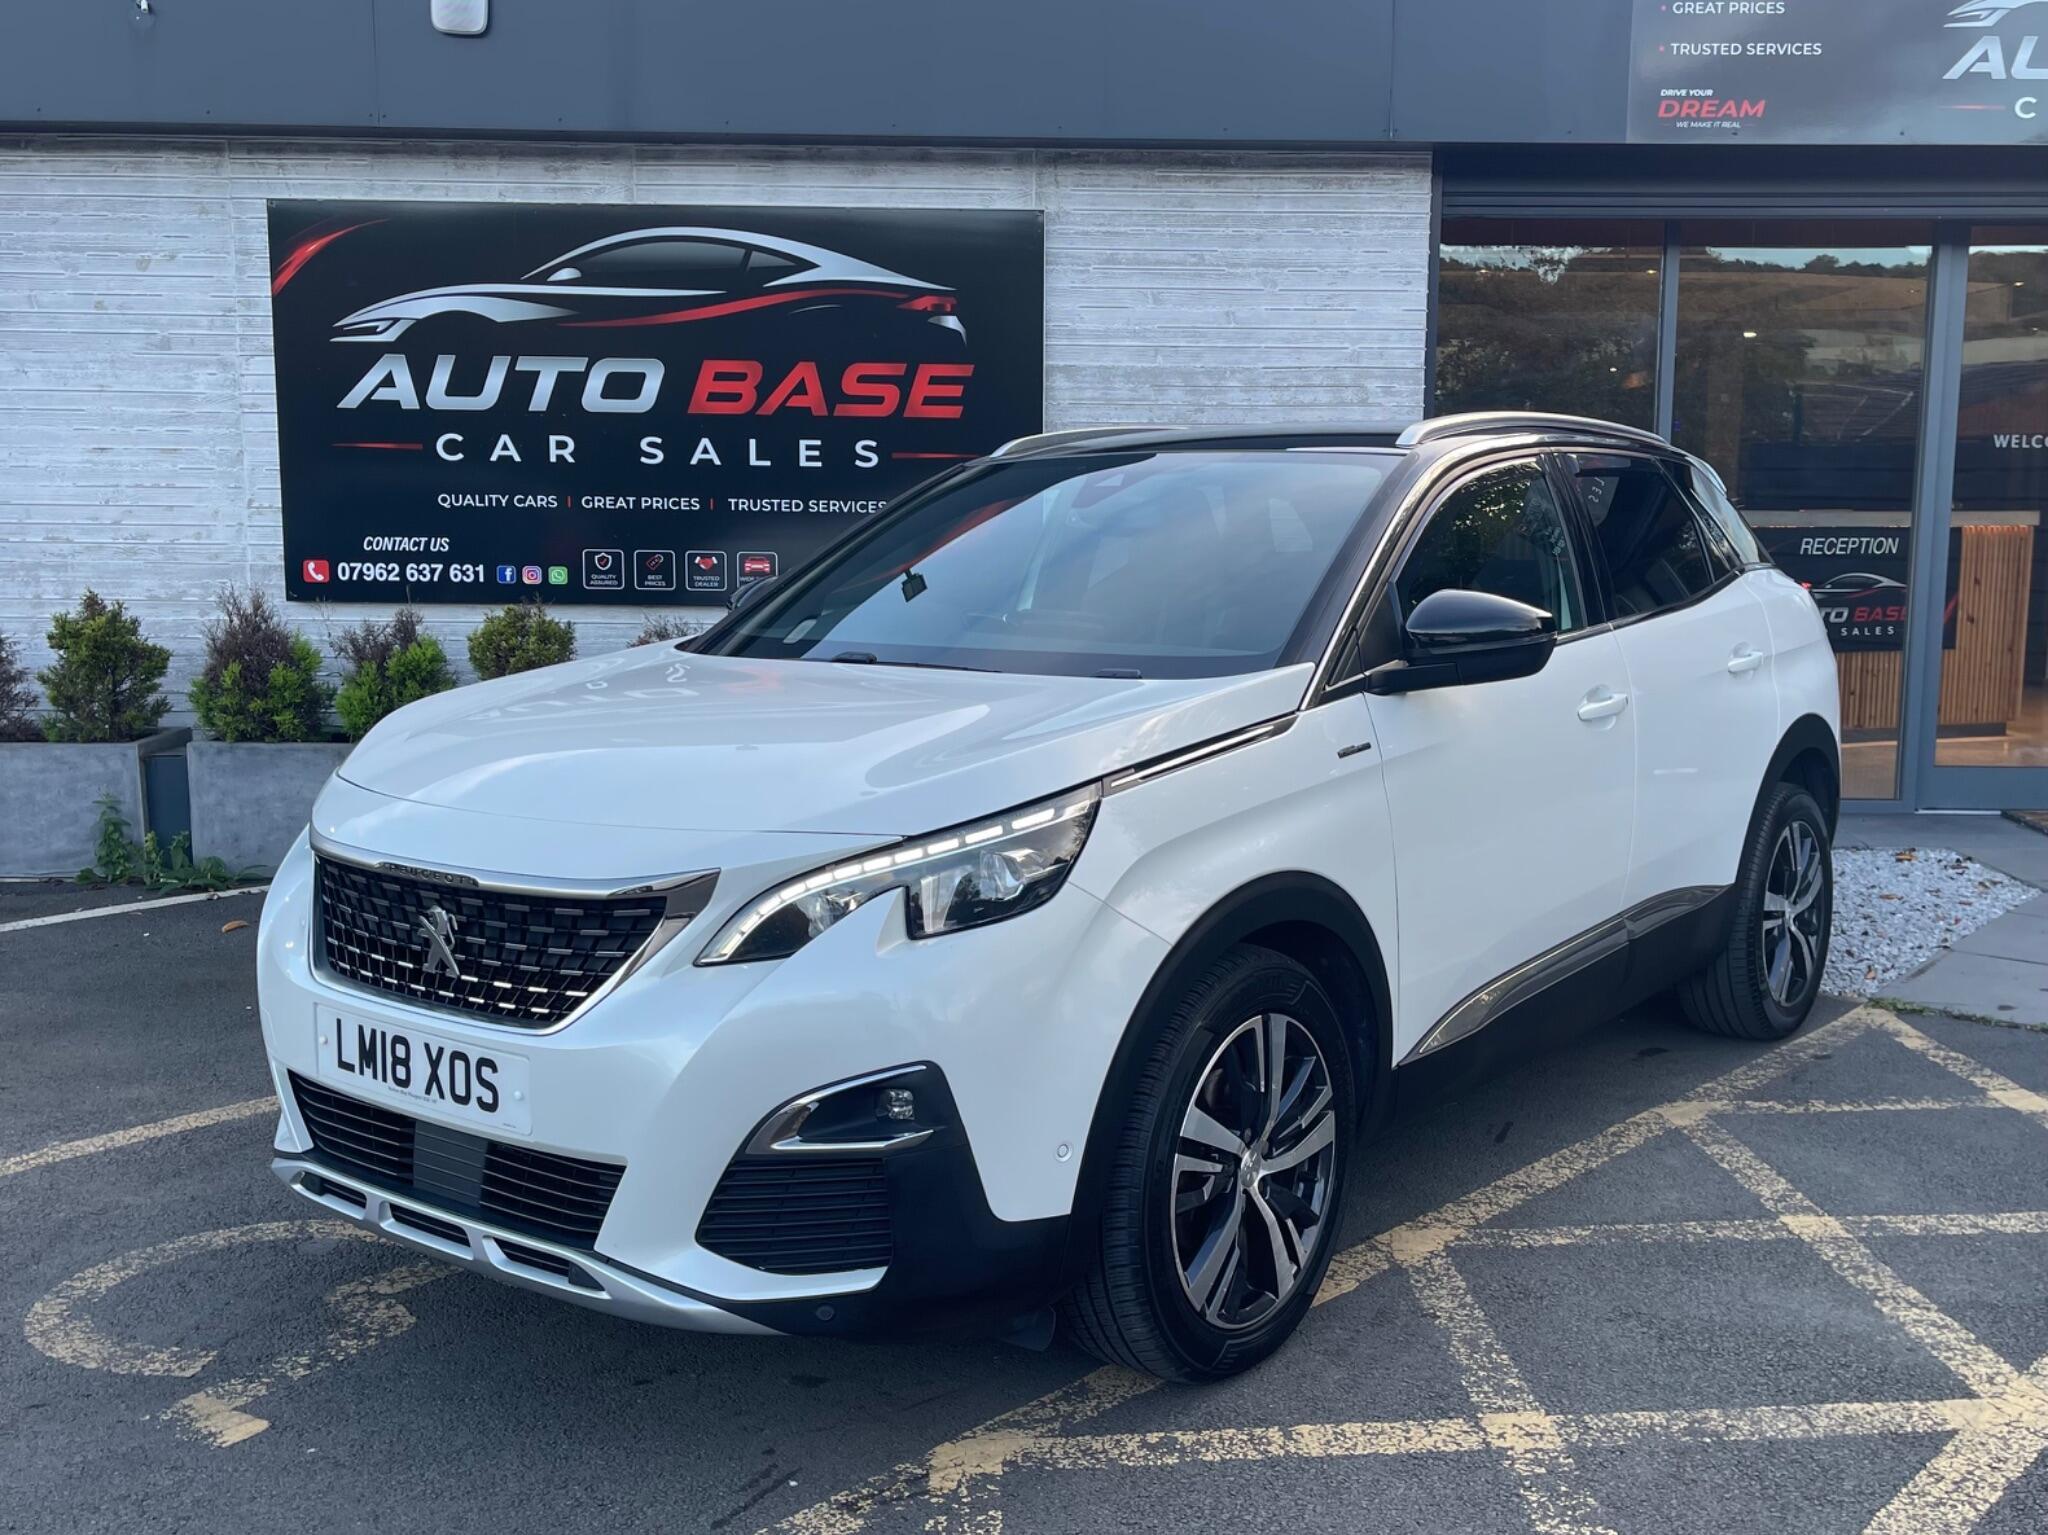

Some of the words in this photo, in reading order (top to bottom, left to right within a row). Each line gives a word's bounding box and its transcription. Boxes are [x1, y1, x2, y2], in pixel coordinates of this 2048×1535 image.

[1672, 2, 1723, 14] GREAT
[1728, 2, 1786, 14] PRICES
[1671, 43, 1742, 56] TRUSTED
[1746, 43, 1822, 56] SERVICES
[1660, 89, 1688, 97] DRIVE
[1689, 89, 1713, 97] YOUR
[1658, 99, 1766, 118] DREAM
[2014, 96, 2037, 119] C
[336, 354, 666, 414] AUTO
[686, 360, 975, 419] BASE
[1993, 434, 2048, 448] WELC
[435, 433, 577, 464] CAR
[639, 436, 881, 468] SALES
[437, 493, 508, 508] QUALITY
[513, 495, 558, 508] CARS
[581, 496, 637, 510] GREAT
[641, 497, 700, 511] PRICES
[728, 498, 804, 512] TRUSTED
[363, 536, 426, 552] CONTACT
[430, 538, 450, 552] US
[1800, 537, 1899, 555] RECEPTION
[337, 562, 400, 581] 07962
[405, 564, 443, 582] 637
[449, 564, 485, 582] 631
[1841, 626, 1895, 636] SALES
[336, 1017, 412, 1089] LM18
[423, 1041, 499, 1113] XOS
